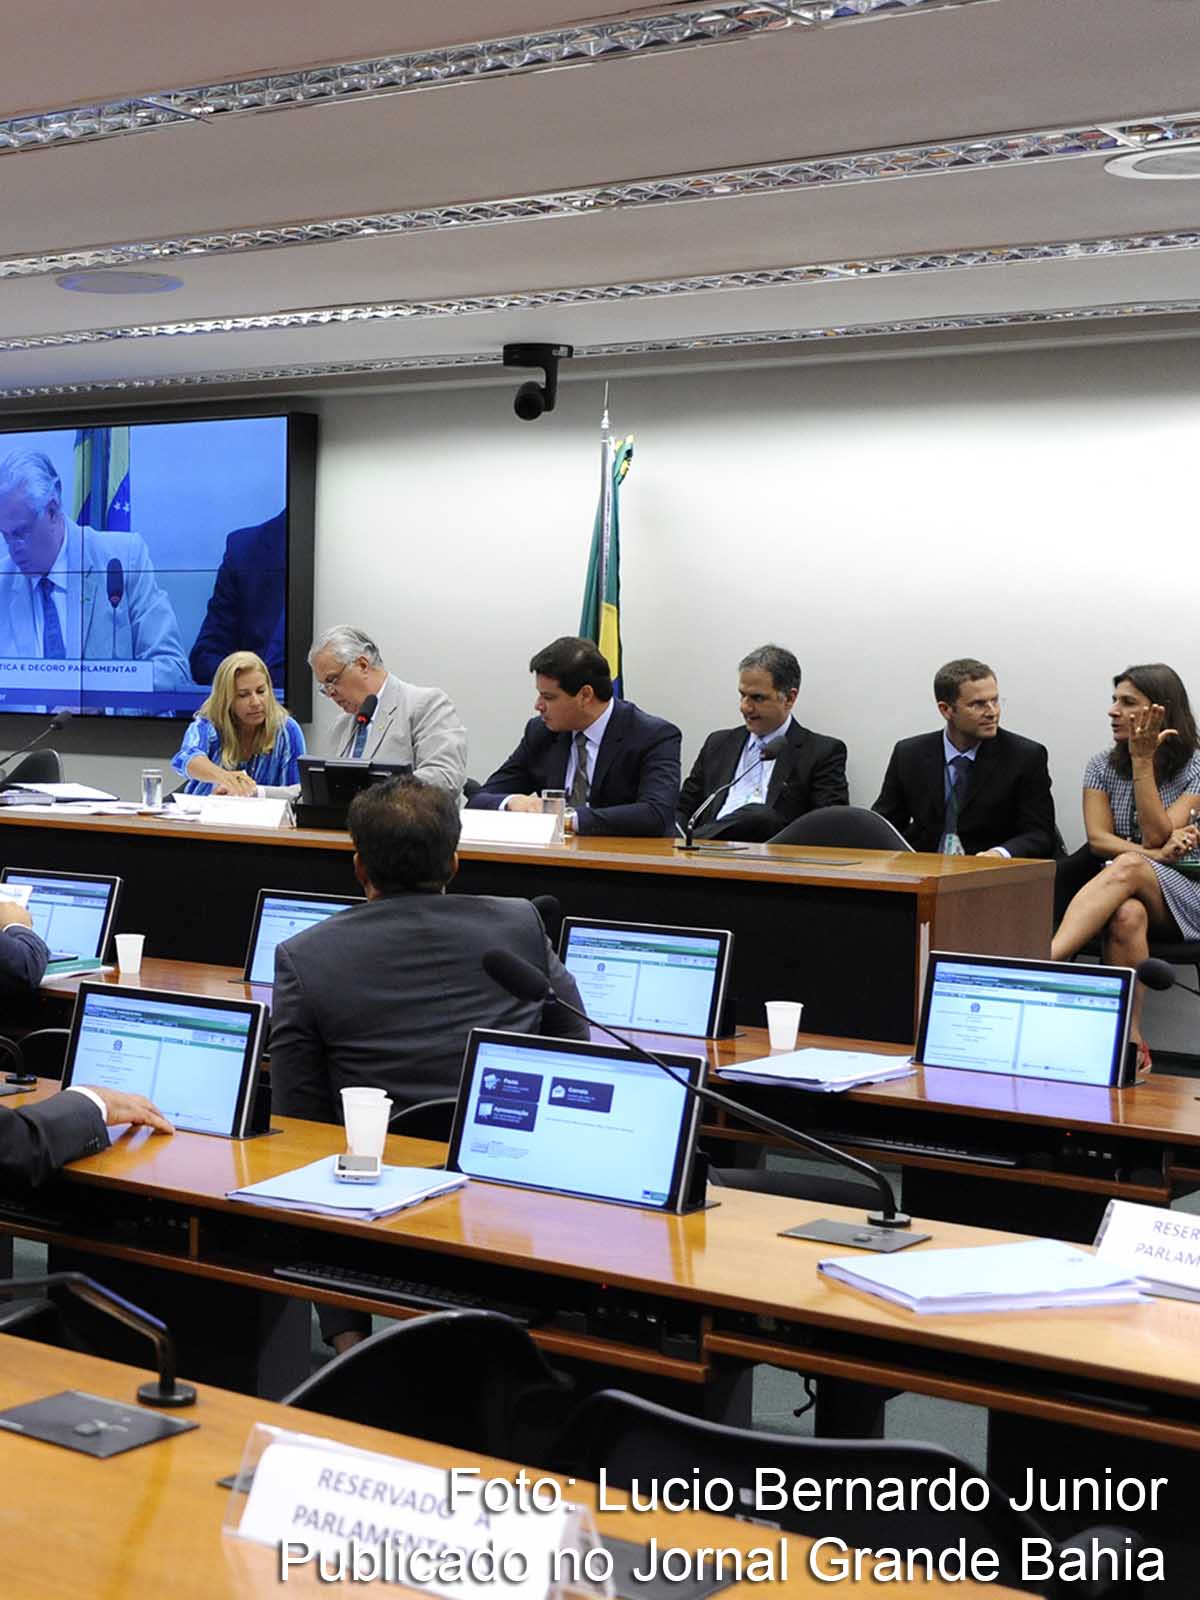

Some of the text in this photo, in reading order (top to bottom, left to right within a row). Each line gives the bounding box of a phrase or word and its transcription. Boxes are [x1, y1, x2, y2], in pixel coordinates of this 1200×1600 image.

[20, 663, 25, 671] E
[28, 663, 66, 672] DECORO
[68, 664, 138, 673] PARLAMENTAR
